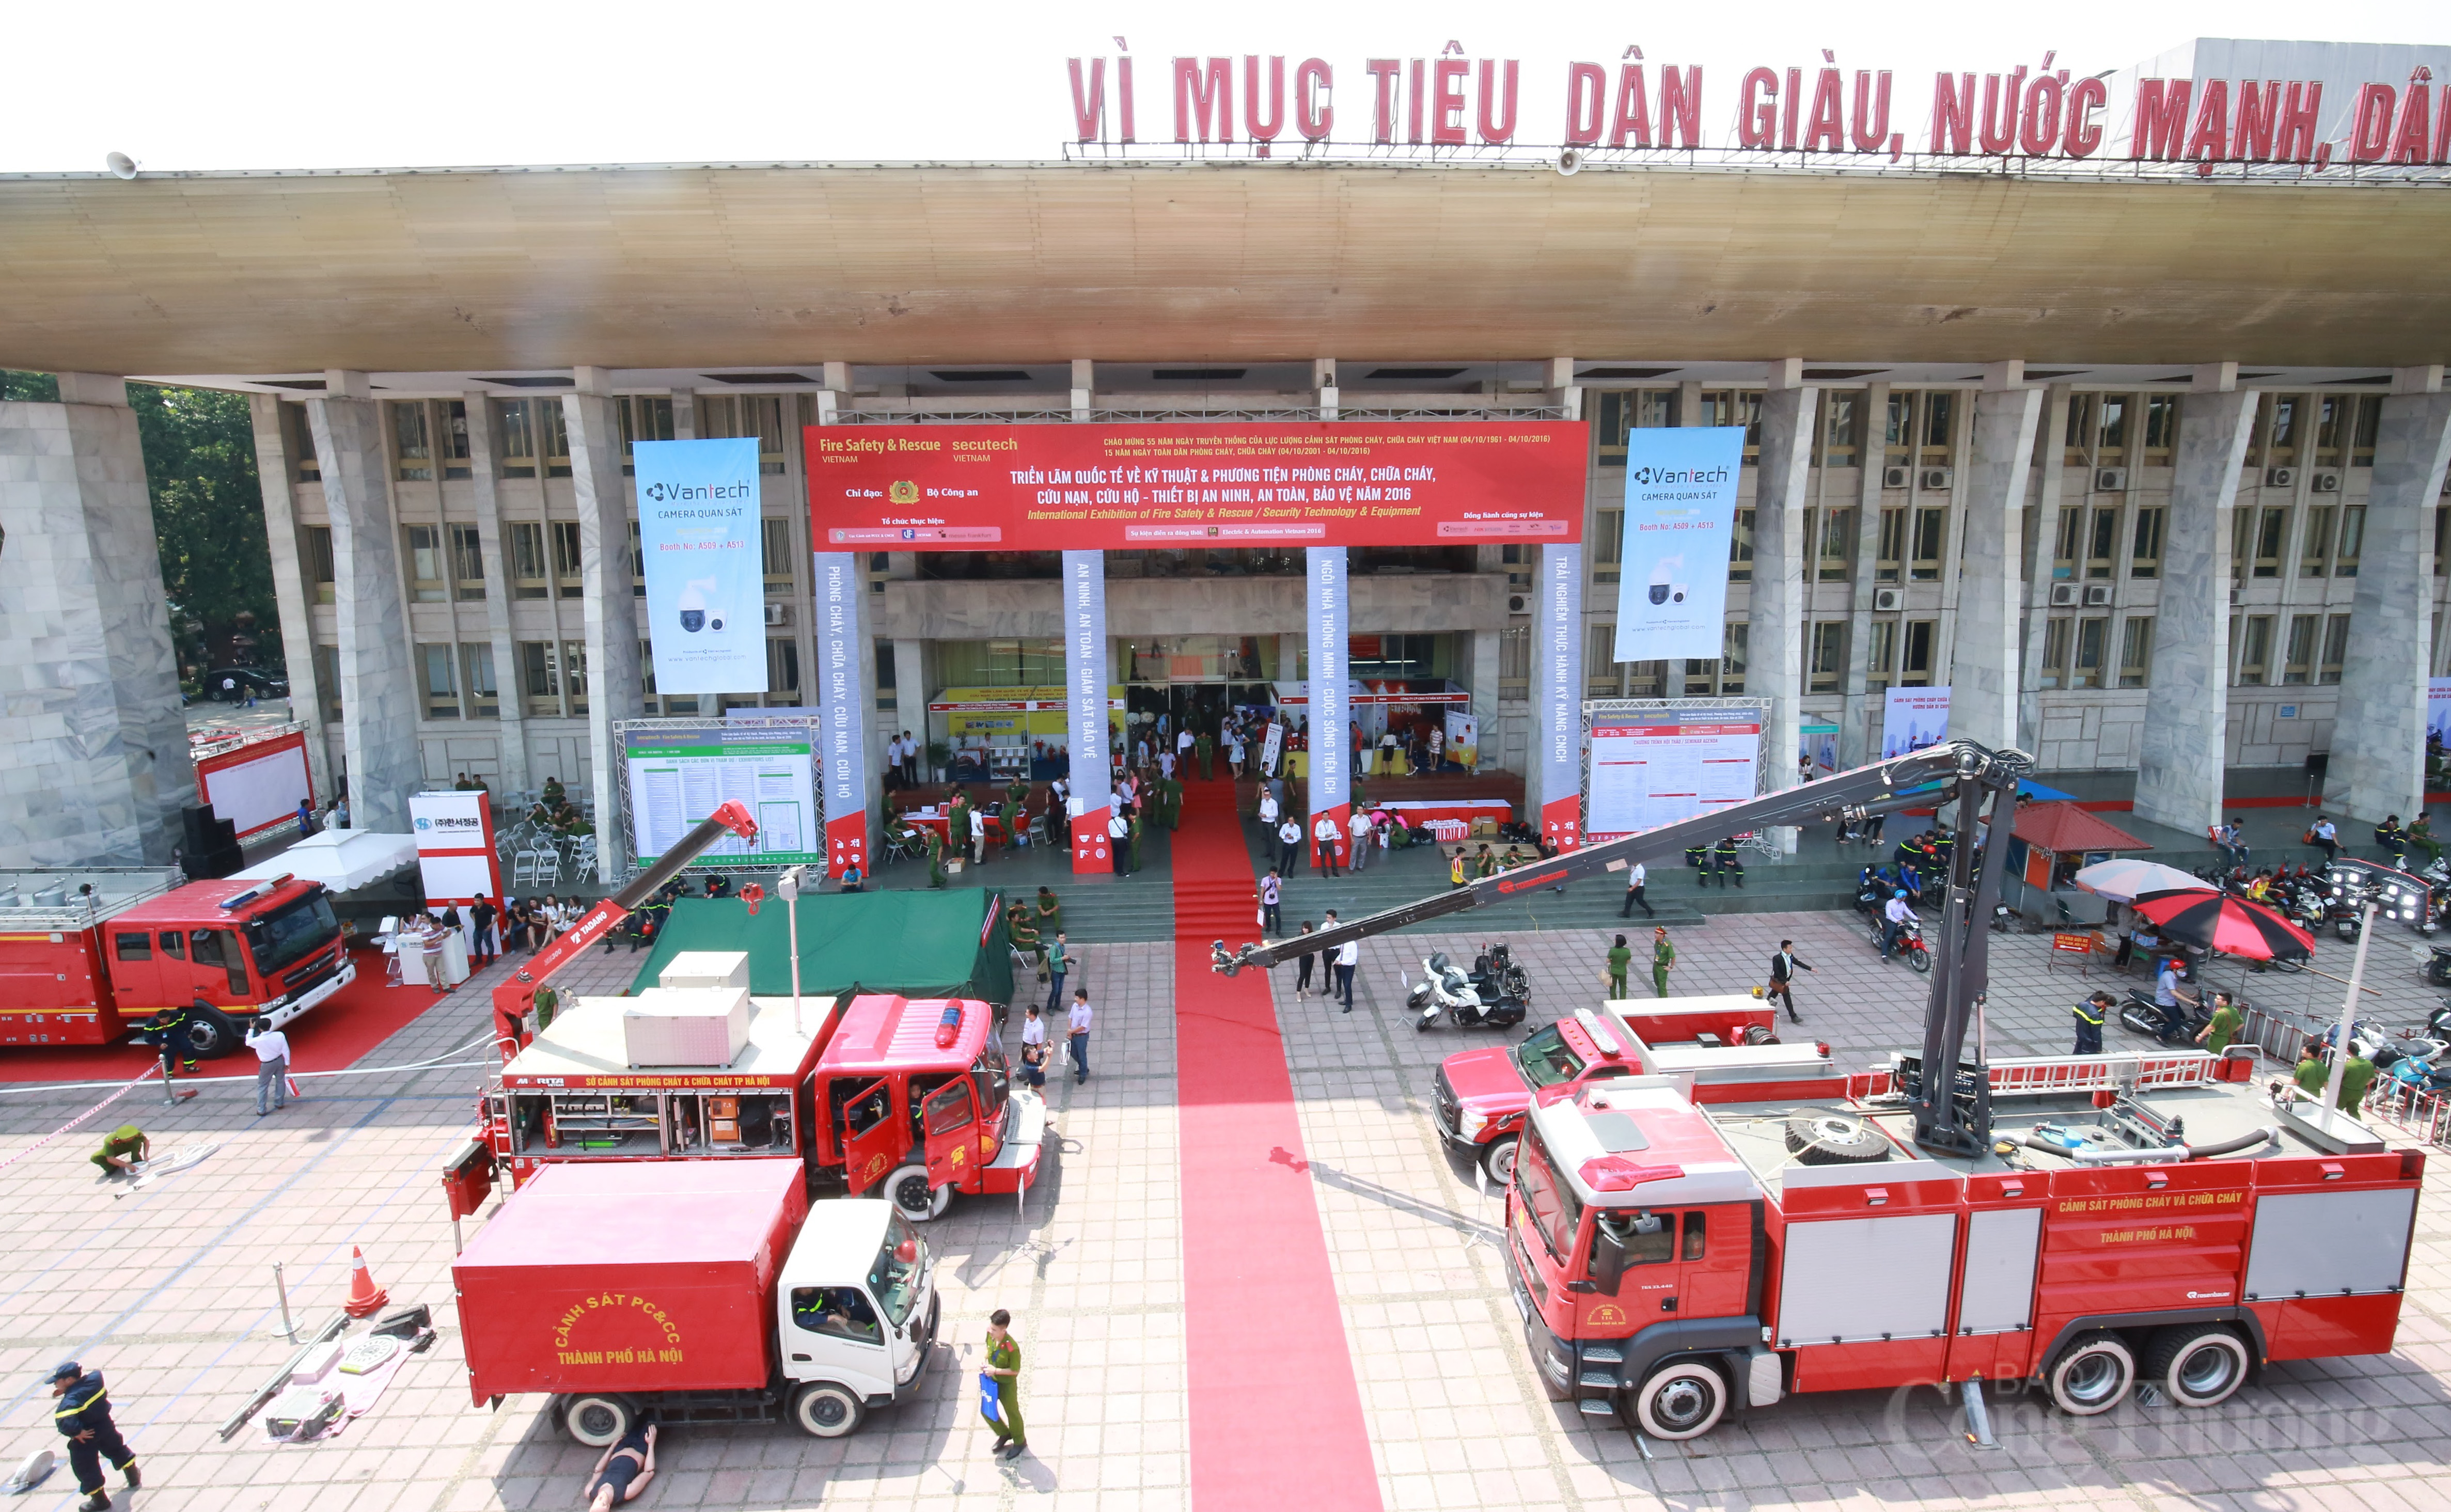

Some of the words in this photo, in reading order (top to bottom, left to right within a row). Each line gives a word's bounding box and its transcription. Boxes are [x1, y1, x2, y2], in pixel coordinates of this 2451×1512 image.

[1065, 35, 1136, 143] VÌ
[1172, 55, 1332, 158] MỤC
[1366, 40, 1519, 144] TIÊU
[1567, 44, 1703, 148] DÂN
[1740, 49, 1904, 164] GIÀU,
[1932, 50, 2105, 158] NƯỚC
[2136, 77, 2334, 176] MẠNH,
[820, 439, 843, 451] Fire
[846, 438, 884, 454] Safety
[887, 439, 897, 451] &
[900, 438, 940, 450] Rescue
[953, 438, 1017, 450] secutech
[1010, 466, 1044, 484] TRIỂN
[1048, 469, 1071, 484] LÃM
[1076, 466, 1106, 484] QUỐC
[1110, 466, 1123, 483] TẾ
[1127, 466, 1141, 483] VỀ
[1145, 468, 1158, 483] KỸ
[1161, 467, 1197, 485] THUẬT
[1201, 469, 1208, 482] &
[1213, 468, 1259, 482] PHƯƠNG
[1263, 466, 1287, 484] TIỆN
[1293, 466, 1330, 481] PHÒNG
[1335, 466, 1366, 483] CHÁY,
[1371, 466, 1400, 481] CHỮA
[1405, 465, 1435, 482] CHÁY,
[1653, 466, 1727, 483] Vantech
[666, 480, 748, 500] Vantech
[863, 490, 883, 498] đạo:
[927, 489, 939, 498] Bộ
[941, 489, 964, 498] Công
[1038, 489, 1060, 504] CỨU
[1065, 491, 1092, 506] NẠN,
[1097, 489, 1119, 503] CỨU
[1124, 488, 1139, 505] HỘ
[1152, 485, 1183, 502] THIẾT
[1187, 490, 1198, 505] BỊ
[1202, 490, 1217, 502] AN
[1222, 489, 1253, 503] NINH,
[1258, 489, 1272, 501] AN
[1276, 486, 1309, 503] TOÀN,
[1314, 485, 1334, 501] BẢO
[1339, 486, 1352, 503] VỆ
[1357, 486, 1380, 500] NĂM
[1385, 487, 1411, 500] 2016
[1701, 490, 1717, 499] SÁT
[658, 510, 695, 518] CAMERA
[698, 509, 723, 518] QUAN
[726, 507, 742, 516] SÁT
[1028, 510, 1087, 519] International
[1090, 509, 1137, 518] Exhibition
[1140, 509, 1151, 518] of
[1153, 509, 1171, 518] Fire
[1174, 509, 1204, 519] Safety
[1207, 508, 1215, 517] &
[1218, 508, 1253, 517] Rescue
[1255, 508, 1262, 518] /
[1263, 507, 1301, 518] Security
[1305, 507, 1357, 518] Technology
[1360, 507, 1367, 515] &
[1371, 506, 1421, 517] Equipment
[1077, 563, 1089, 577] AN
[1321, 560, 1335, 584] NGÔI
[1556, 556, 1570, 578] TRẢI
[829, 566, 843, 601] PHÒNG
[1077, 582, 1090, 609] NINH,
[1322, 589, 1335, 609] NHÀ
[1554, 583, 1569, 621] NGHIỆM
[829, 606, 844, 636] CHÁY,
[1079, 613, 1091, 627] AN
[1322, 613, 1336, 648] THÔNG
[1080, 631, 1093, 658] TOÀN
[1554, 625, 1568, 651] THỰC
[831, 640, 845, 668] CHỮA
[1323, 652, 1334, 678] MINH
[1556, 655, 1569, 682] HÀNH
[832, 672, 847, 702] CHÁY,
[1081, 669, 1095, 694] GIÁM
[1322, 689, 1337, 716] CUỘC
[1556, 687, 1568, 699] KỸ
[835, 706, 848, 727] CỨU
[1082, 698, 1095, 717] SÁT
[1556, 704, 1568, 731] NĂNG
[1083, 721, 1097, 742] BẢO
[1324, 720, 1339, 747] SỐNG
[834, 731, 847, 755] NẠN,
[1082, 746, 1097, 758] VỆ
[1556, 735, 1566, 762] CNCH
[837, 760, 850, 780] CỨU
[1324, 751, 1337, 773] TIỆN
[836, 784, 850, 798] HỘ
[1325, 777, 1338, 794] ÍCH
[435, 818, 478, 827] (주)한서정공
[580, 911, 607, 935] TADANO
[586, 1076, 597, 1085] SỞ
[598, 1076, 618, 1085] CẢNH
[620, 1076, 634, 1085] SÁT
[636, 1076, 661, 1085] PHÒNG
[663, 1076, 681, 1085] CHÁY
[692, 1077, 711, 1085] CHỮA
[714, 1076, 732, 1085] CHÁY
[745, 1076, 755, 1085] HÀ
[757, 1076, 769, 1086] NỘI
[2060, 1198, 2086, 1212] CẢNH
[2089, 1198, 2108, 1210] SÁT
[2110, 1196, 2143, 1209] PHÒNG
[2146, 1195, 2171, 1207] CHÁY
[2174, 1194, 2185, 1206] VÀ
[2189, 1192, 2213, 1205] CHỮA
[2217, 1191, 2242, 1203] CHÁY
[2101, 1227, 2134, 1243] THÀNH
[2136, 1227, 2157, 1240] PHỐ
[2159, 1227, 2172, 1239] HÀ
[2175, 1226, 2193, 1239] NỘI
[553, 1304, 585, 1347] CẢNH
[587, 1292, 625, 1308] SÁT
[631, 1296, 680, 1343] PC&CC
[558, 1350, 603, 1364] THÀNH
[606, 1347, 633, 1363] PHỐ
[637, 1348, 656, 1363] HÀ
[659, 1347, 683, 1364] NỘI
